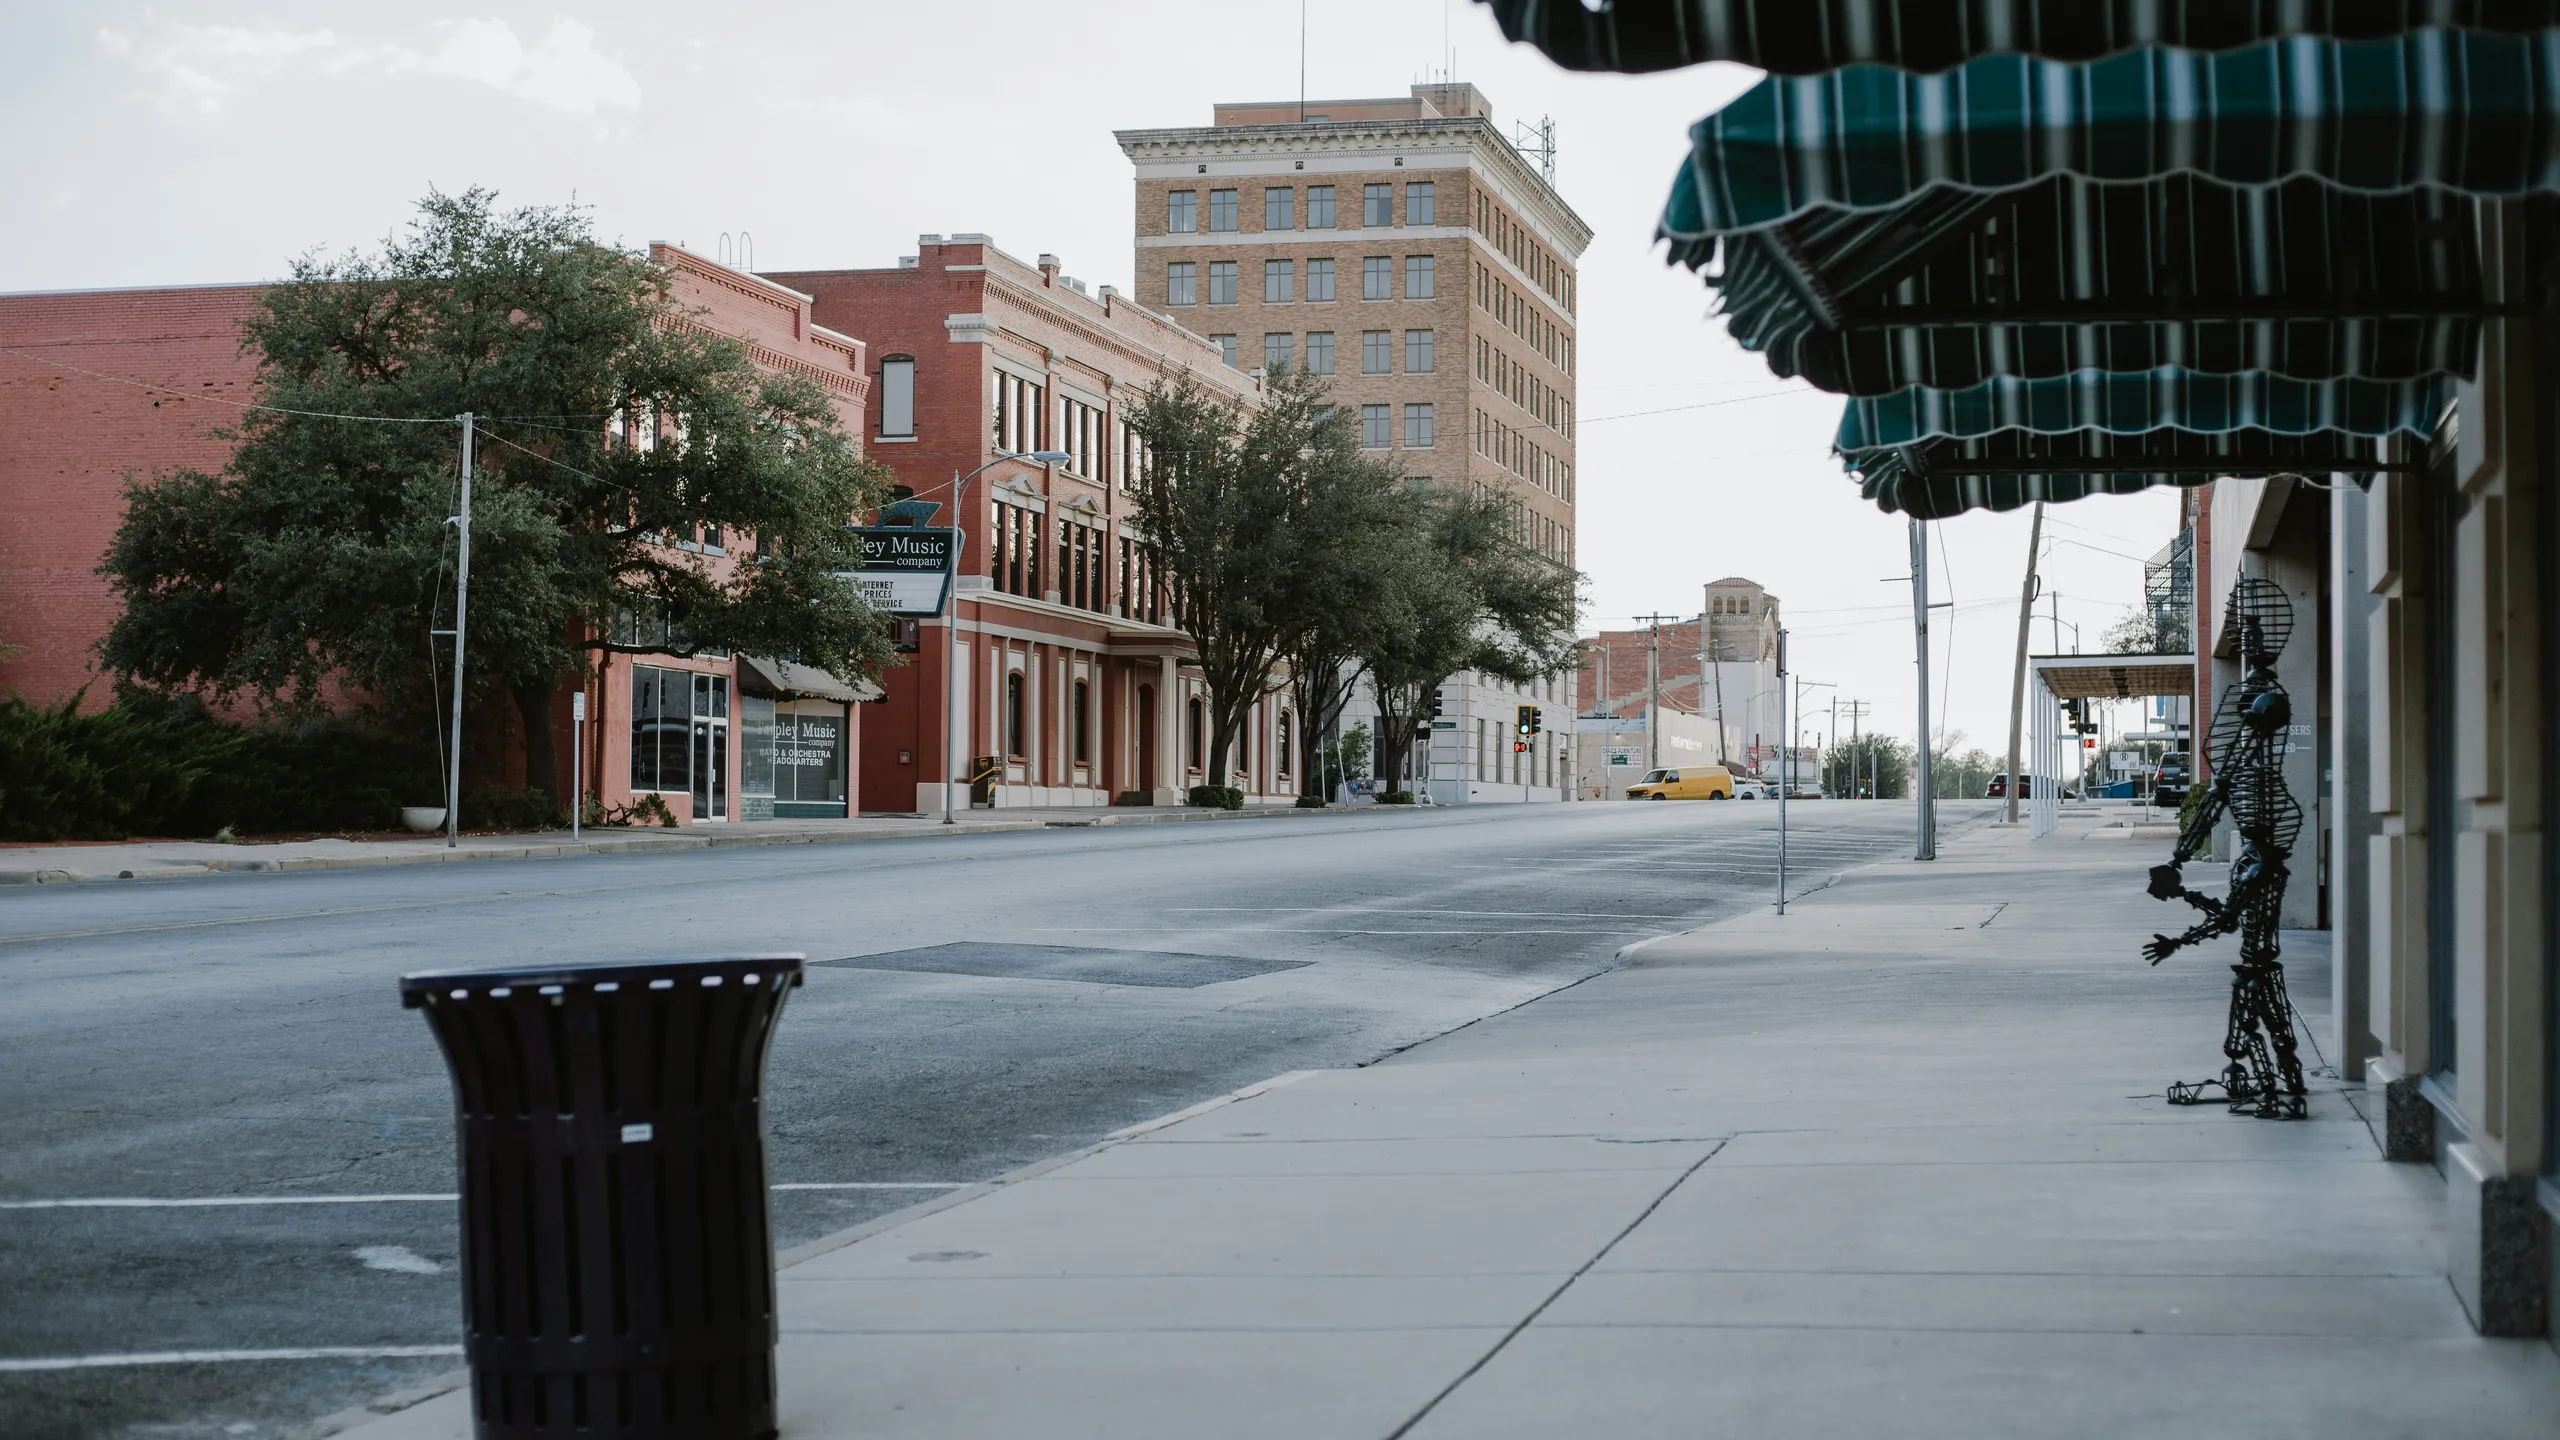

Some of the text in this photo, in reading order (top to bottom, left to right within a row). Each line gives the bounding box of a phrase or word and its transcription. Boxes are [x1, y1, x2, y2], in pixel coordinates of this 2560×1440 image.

[891, 536, 944, 554] Music
[896, 557, 943, 568] company
[864, 590, 892, 599] PRICES
[802, 723, 836, 738] Music
[808, 739, 835, 748] company
[759, 748, 779, 756] BAND
[788, 749, 831, 758] ORCHESTRA
[767, 757, 823, 766] HEADQUARTERS
